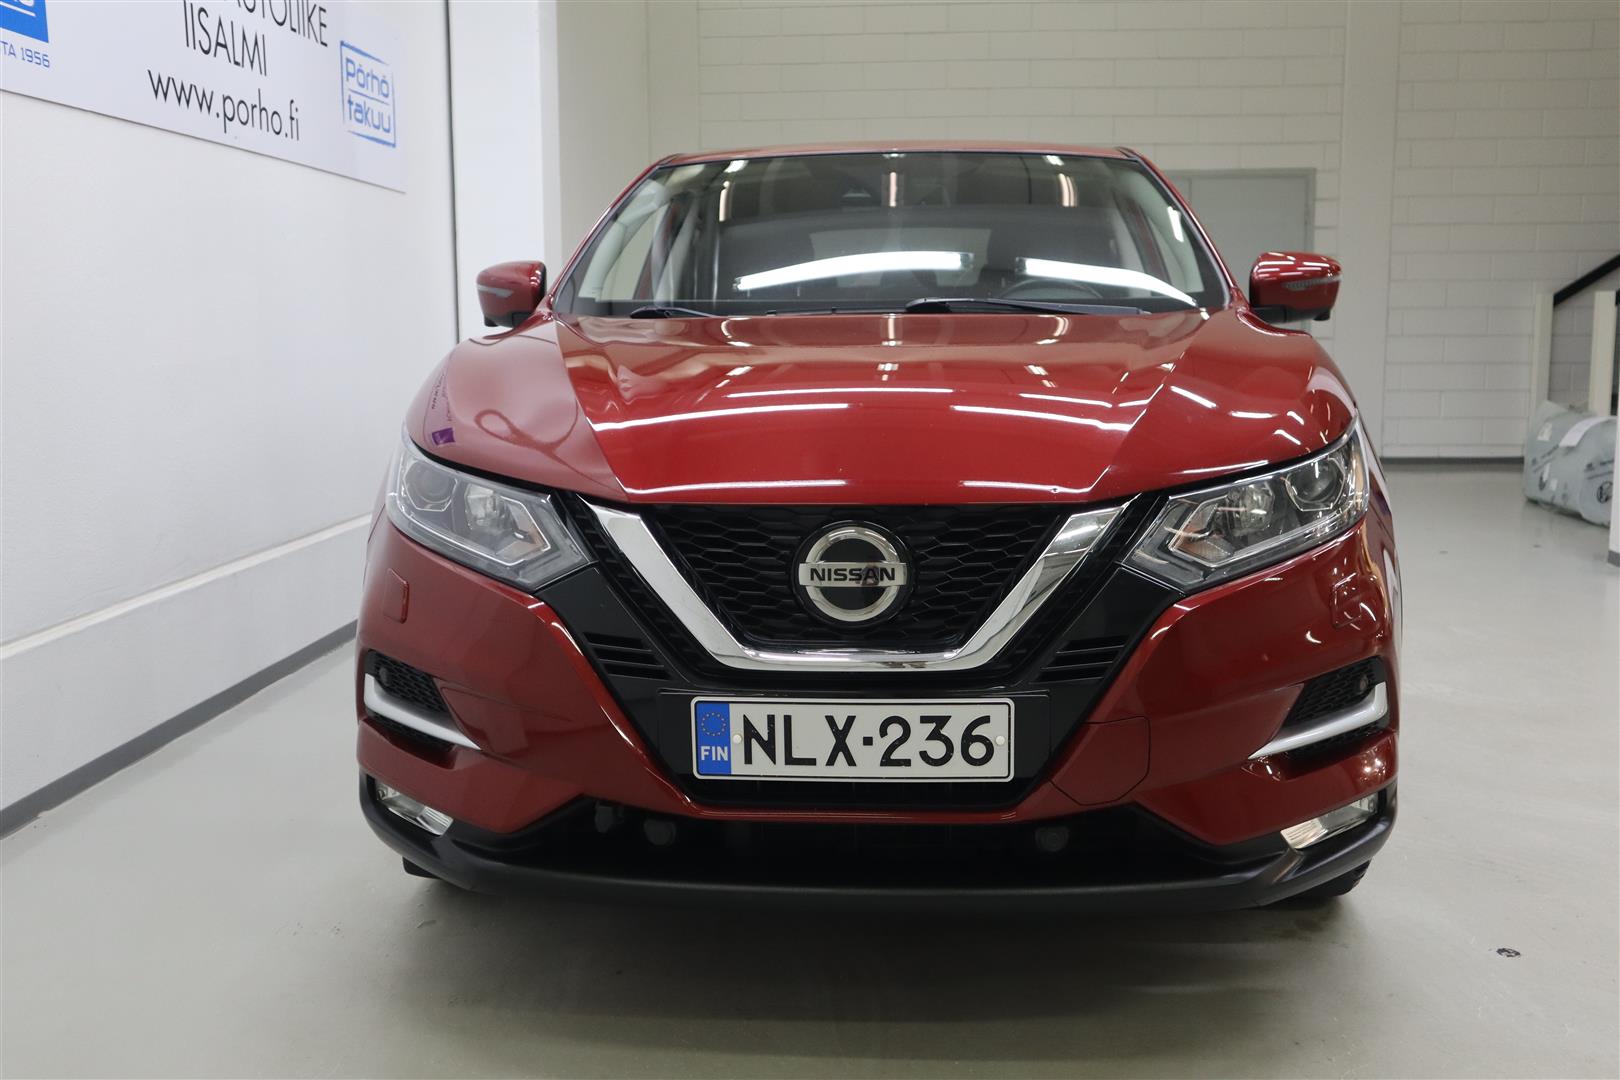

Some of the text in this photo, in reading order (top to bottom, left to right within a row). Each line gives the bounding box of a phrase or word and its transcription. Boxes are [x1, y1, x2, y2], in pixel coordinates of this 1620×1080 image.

[183, 0, 267, 76] IISALMI
[237, 0, 328, 47] OLIIKE
[20, 47, 50, 68] 1956
[147, 69, 300, 141] www.porho.fi
[347, 94, 391, 133] takuu
[810, 567, 895, 582] NISSAN
[700, 746, 729, 761] FIN
[742, 713, 995, 767] NLX-236
